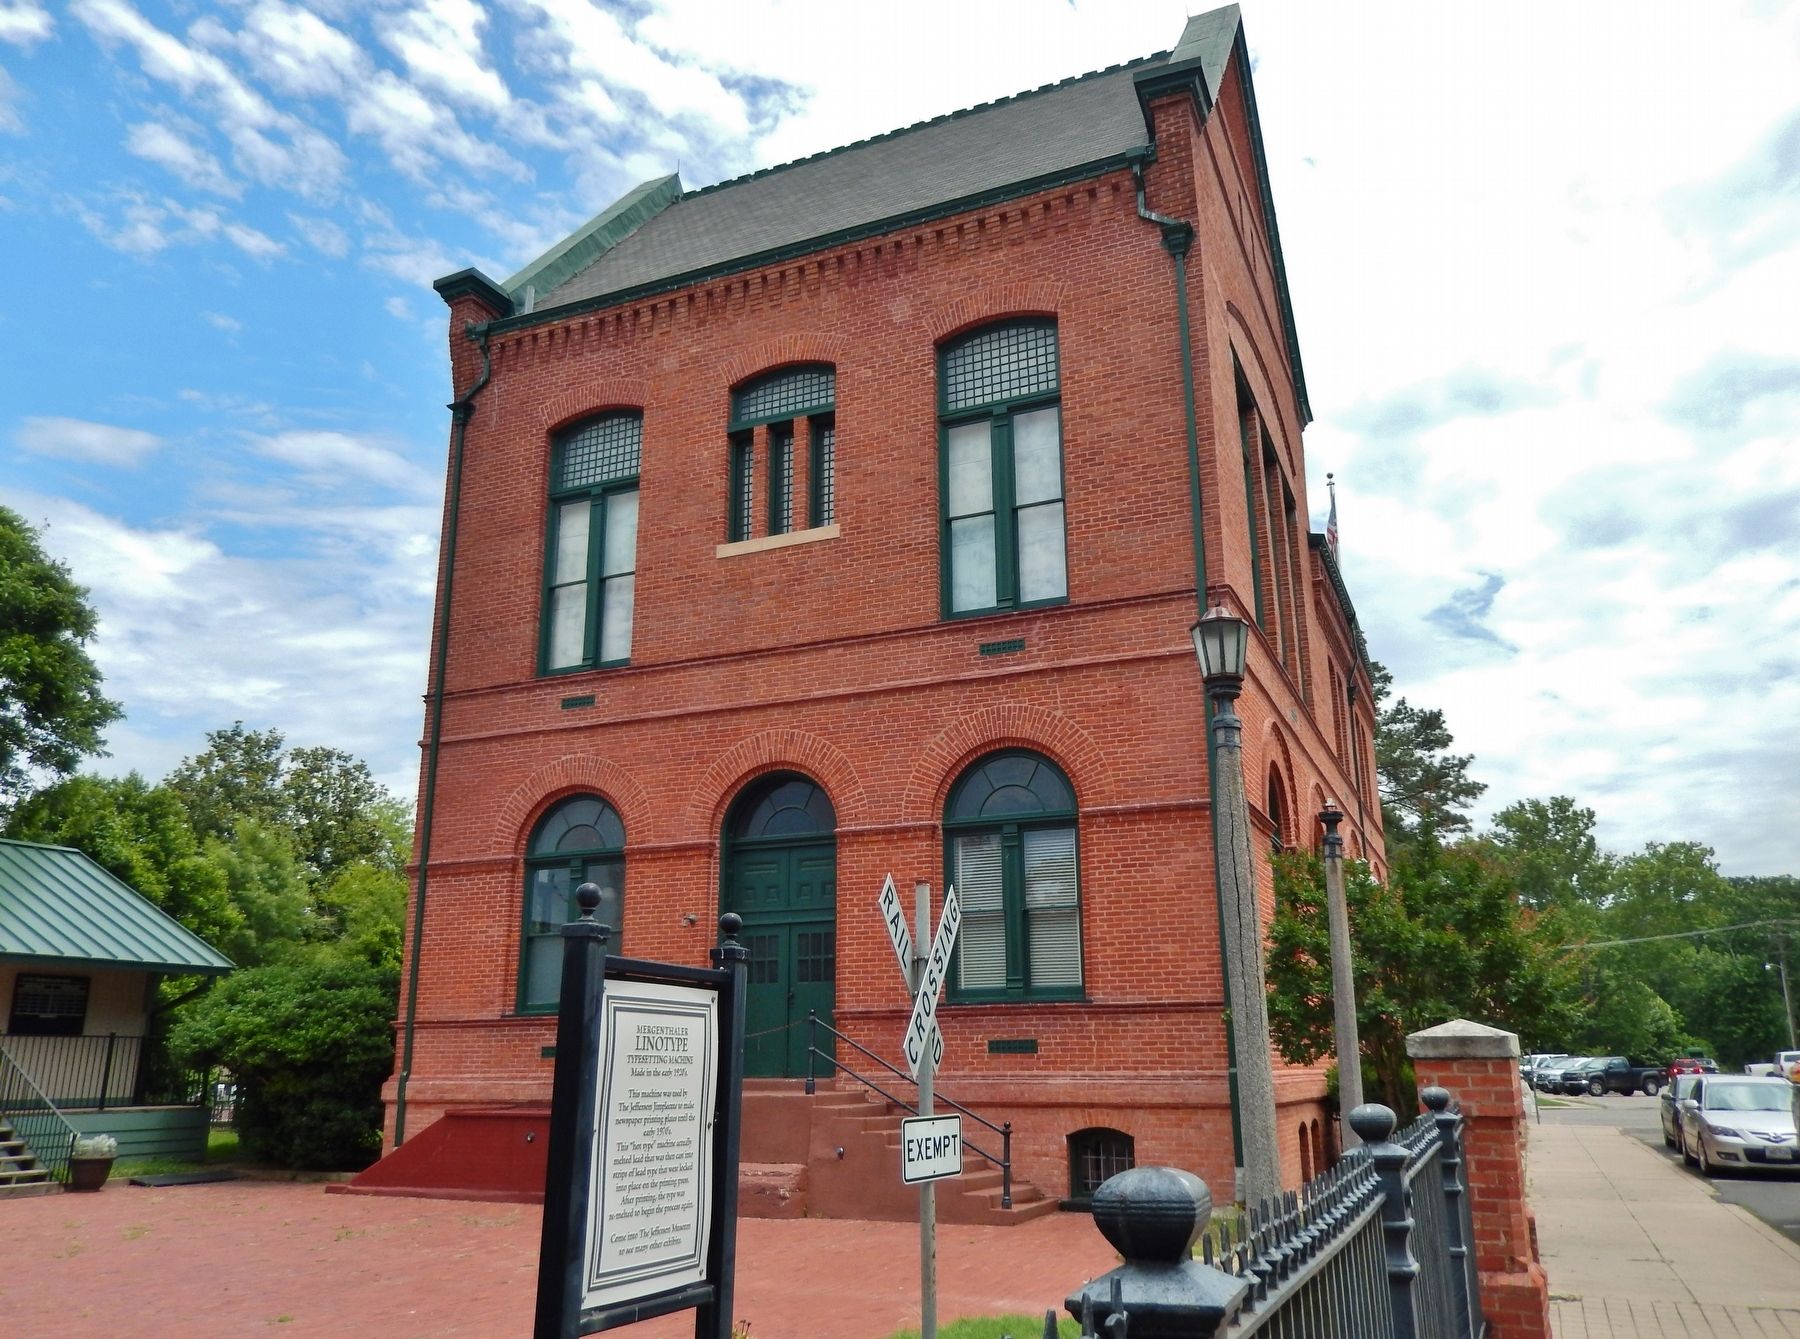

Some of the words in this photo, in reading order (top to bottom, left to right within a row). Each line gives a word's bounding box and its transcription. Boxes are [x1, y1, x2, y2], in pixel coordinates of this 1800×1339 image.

[883, 884, 908, 969] RAIL
[908, 898, 958, 1065] CROSSING
[636, 1025, 688, 1036] MERGENTHALER
[635, 1035, 688, 1052] LINOTYPE
[627, 1054, 668, 1064] TYPESETTING
[668, 1055, 694, 1065] MACHINE
[630, 1067, 645, 1077] Made
[653, 1067, 661, 1077] the
[661, 1067, 673, 1079] early
[628, 1089, 640, 1098] This
[641, 1088, 662, 1098] machine
[672, 1088, 682, 1098] used
[683, 1088, 688, 1100] by
[619, 1102, 629, 1112] The
[629, 1101, 652, 1113] Jefferson
[615, 1117, 643, 1128] newspaper
[644, 1114, 664, 1126] printing
[678, 1113, 688, 1122] until
[643, 1127, 655, 1138] early
[617, 1142, 629, 1152] This
[657, 1139, 676, 1149] machine
[676, 1137, 692, 1149] actually
[907, 1134, 958, 1163] EXEMPT
[613, 1155, 632, 1165] melted
[632, 1154, 644, 1164] lead
[644, 1153, 655, 1163] that
[655, 1154, 665, 1162] was
[665, 1151, 675, 1161] then
[675, 1152, 684, 1160] cast
[684, 1150, 694, 1159] into
[613, 1169, 628, 1180] strips
[628, 1167, 636, 1178] of
[635, 1166, 646, 1176] lead
[647, 1167, 658, 1178] type
[658, 1165, 668, 1175] that
[668, 1165, 679, 1173] were
[679, 1162, 694, 1172] locked
[616, 1183, 627, 1192] into
[628, 1181, 641, 1194] place
[650, 1179, 658, 1188] the
[659, 1177, 677, 1189] printing
[620, 1194, 635, 1205] After
[658, 1191, 666, 1200] the
[666, 1191, 676, 1202] type
[641, 1206, 655, 1218] begin
[655, 1204, 664, 1214] the
[664, 1203, 680, 1215] process
[610, 1232, 626, 1243] Come
[627, 1229, 638, 1240] into
[639, 1228, 650, 1239] The
[650, 1225, 671, 1239] Jefferson
[671, 1223, 691, 1233] Museum
[625, 1246, 634, 1255] see
[635, 1244, 648, 1254] many
[649, 1241, 662, 1250] other
